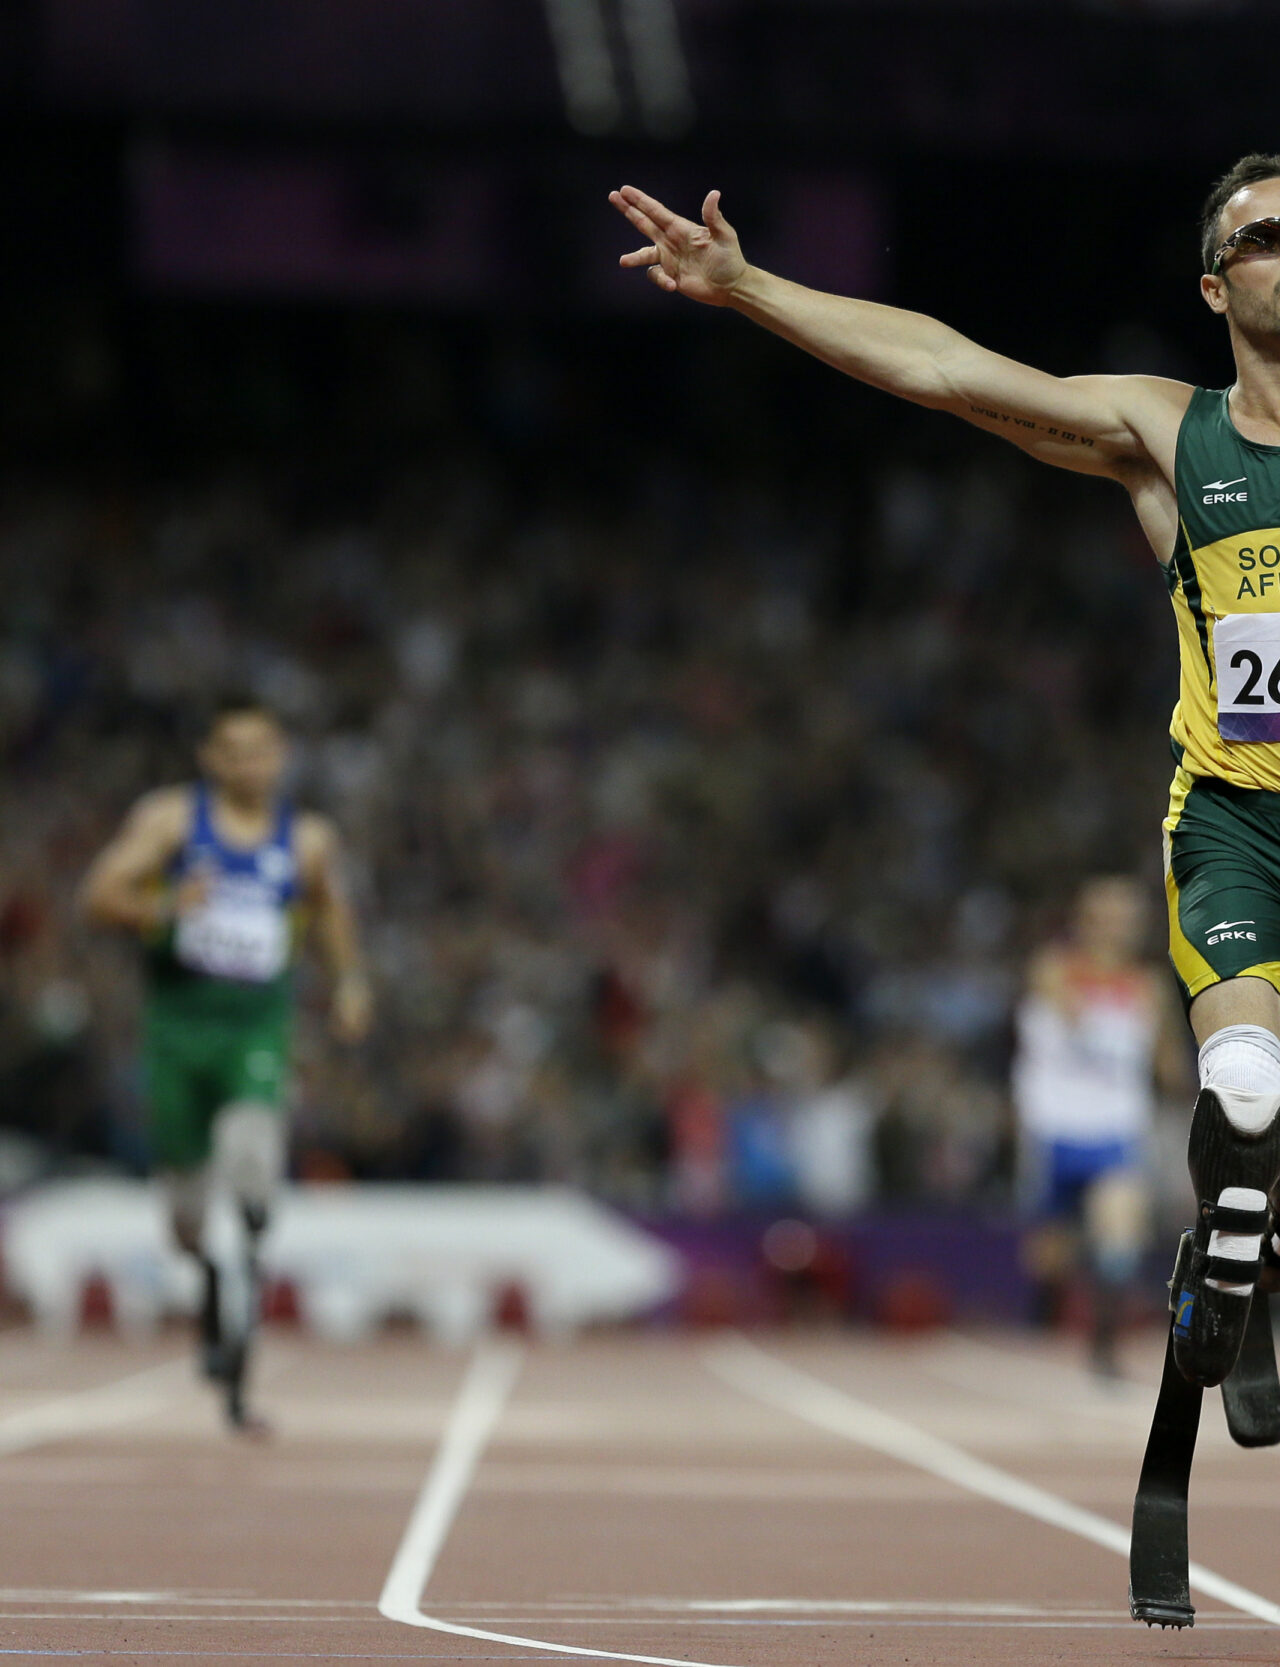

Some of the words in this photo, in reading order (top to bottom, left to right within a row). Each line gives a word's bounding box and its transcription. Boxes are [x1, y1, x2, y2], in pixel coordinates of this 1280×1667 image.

[1080, 435, 1095, 448] VI
[1203, 492, 1248, 505] ERKE
[1207, 931, 1257, 946] ERKE
